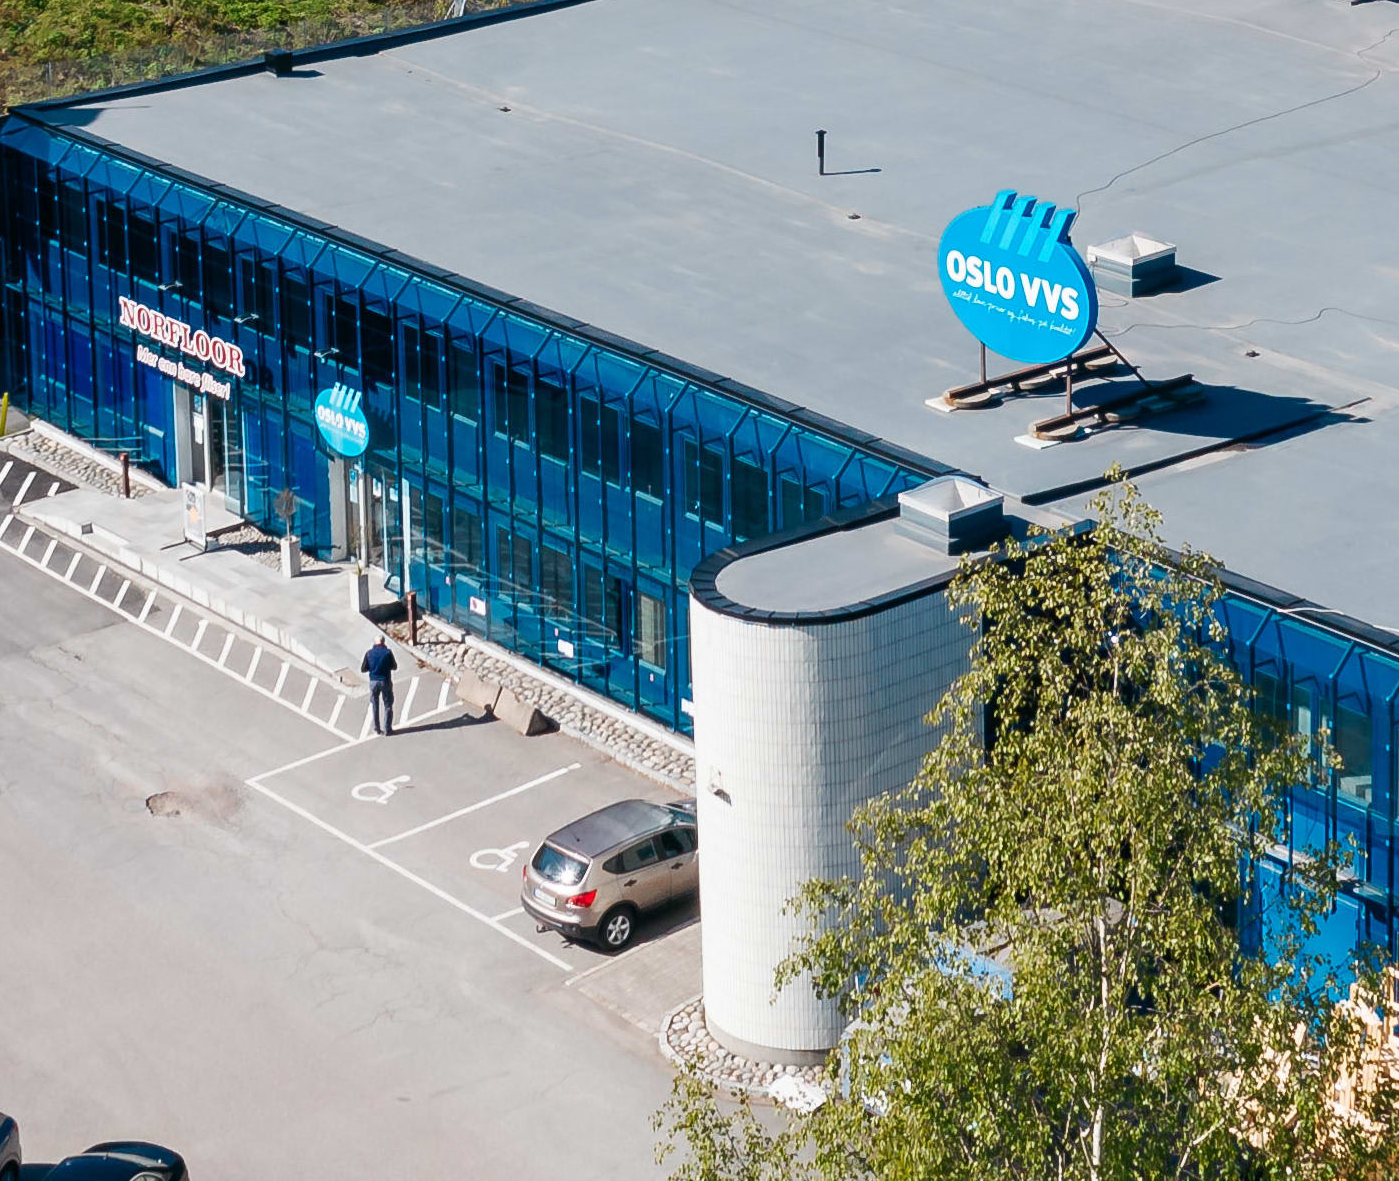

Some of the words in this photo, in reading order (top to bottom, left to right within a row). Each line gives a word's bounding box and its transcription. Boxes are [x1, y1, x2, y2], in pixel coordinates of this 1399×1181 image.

[946, 249, 1016, 300] OSLO
[1020, 273, 1080, 321] VVS
[119, 295, 246, 378] NORFLOOR
[136, 344, 159, 368] Mer
[177, 361, 201, 388] bare
[317, 404, 345, 429] OSLO
[344, 415, 367, 440] VVS
